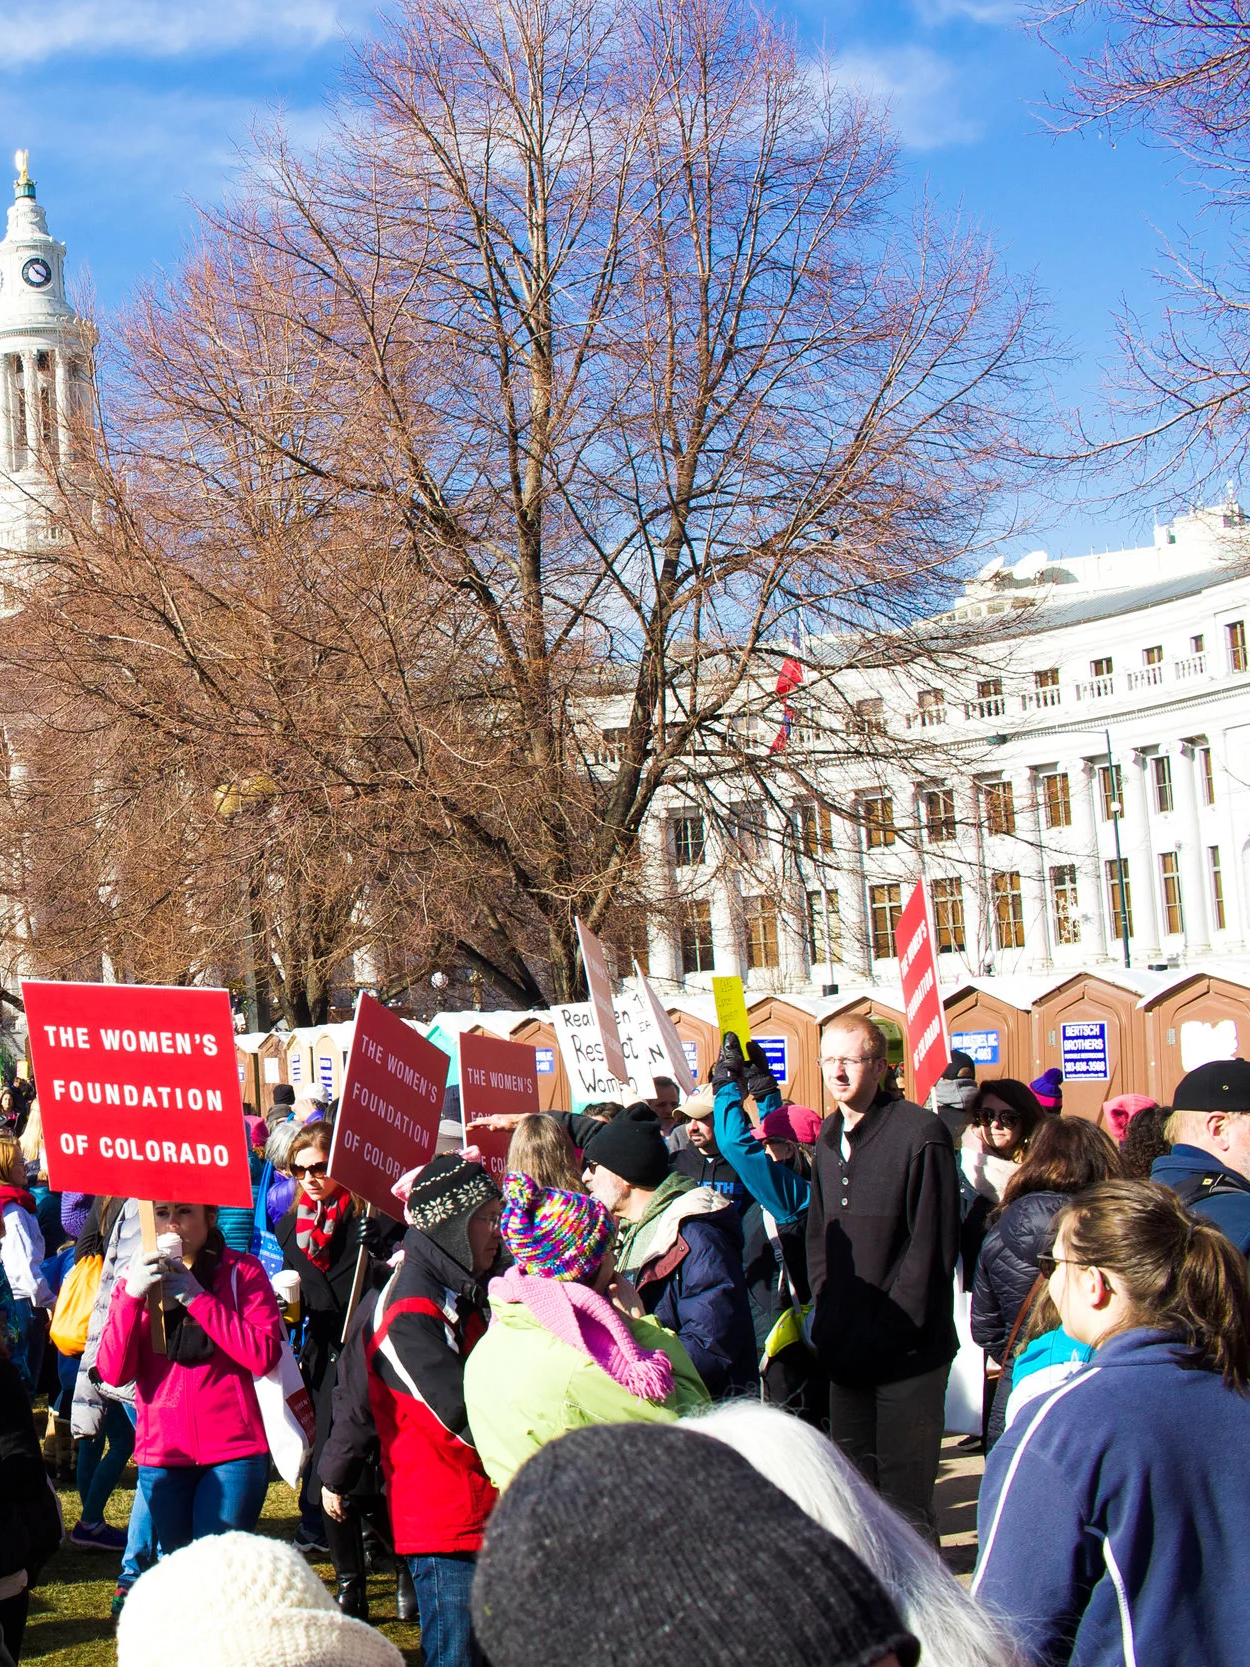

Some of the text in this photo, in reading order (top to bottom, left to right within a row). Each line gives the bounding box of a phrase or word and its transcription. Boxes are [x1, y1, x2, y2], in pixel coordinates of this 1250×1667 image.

[900, 919, 927, 980] THE WOMEN'S
[906, 967, 934, 1026] FOUNDATION
[561, 1007, 631, 1027] Real en
[1065, 1024, 1100, 1037] BERTSCH
[44, 1025, 218, 1056] THE WOMEN'S
[571, 1033, 639, 1064] Resct
[918, 1015, 941, 1062] COLORADO
[1064, 1038, 1104, 1051] BROTHERS
[362, 1034, 438, 1104] THE WOMEN'S
[467, 1068, 533, 1094] THE WOMEN'S
[53, 1079, 223, 1112] FOUNDATION
[352, 1082, 430, 1149] FOUNDATION
[60, 1133, 229, 1167] OF COLORADO
[344, 1129, 407, 1181] OF COLORA
